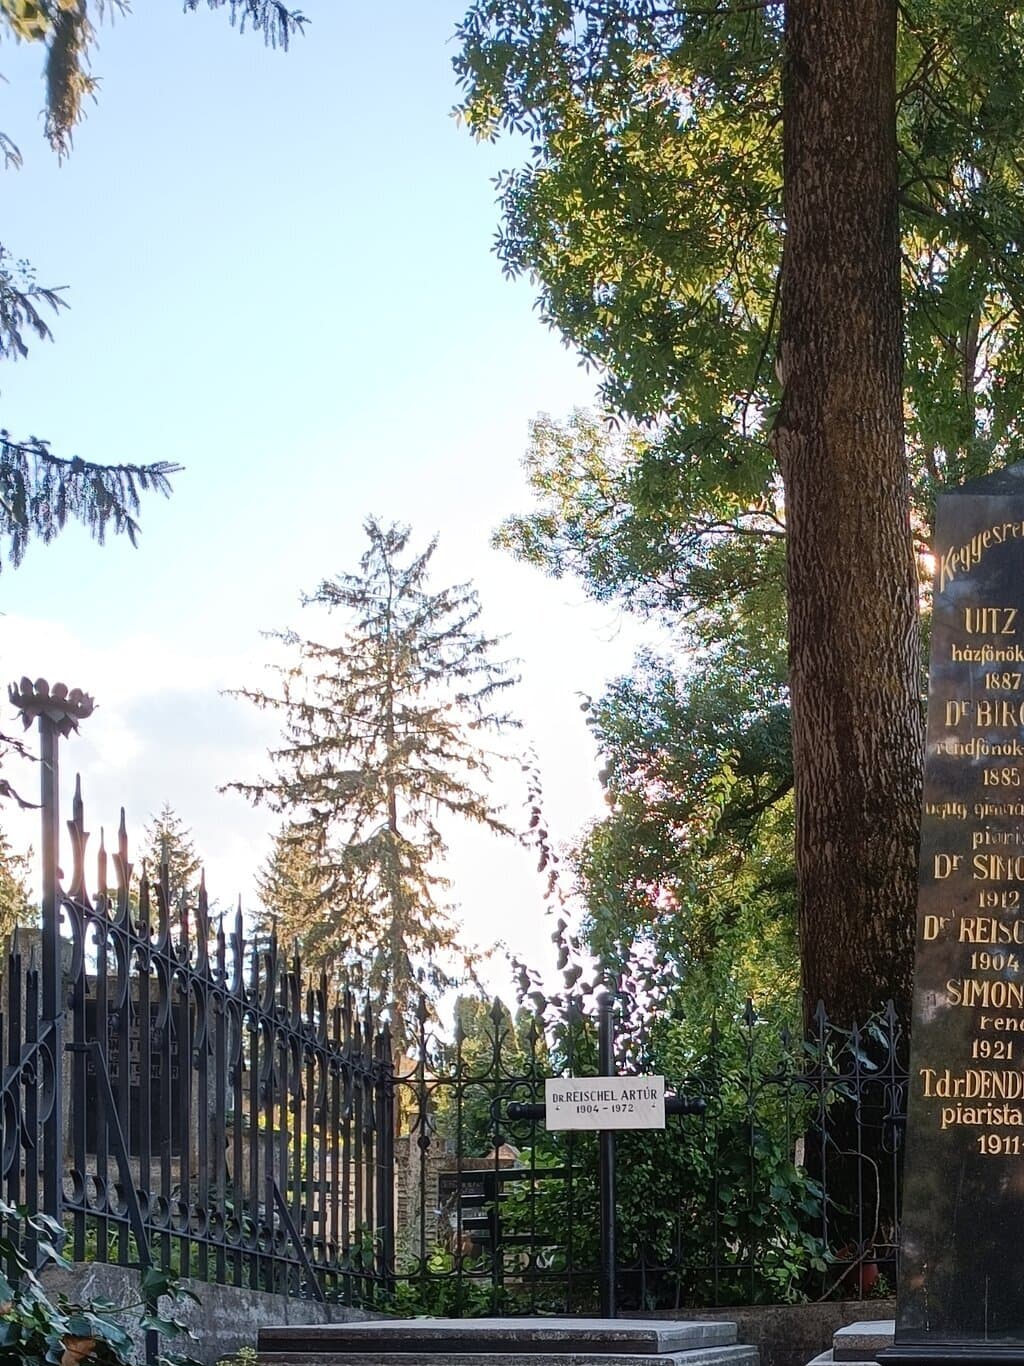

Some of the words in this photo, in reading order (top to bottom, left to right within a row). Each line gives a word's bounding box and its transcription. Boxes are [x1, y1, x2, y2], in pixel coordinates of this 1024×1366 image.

[965, 608, 1016, 635] UITZ
[985, 672, 1022, 690] 1887
[983, 768, 1020, 786] 1885
[979, 890, 1020, 909] 1912
[970, 952, 1020, 972] 1904
[946, 979, 1023, 1009] SIMON
[972, 1039, 1013, 1060] 1921
[621, 1087, 658, 1101] ARTÚR
[576, 1105, 599, 1113] 1904
[611, 1104, 634, 1112] 1972
[941, 1102, 1022, 1129] piarista
